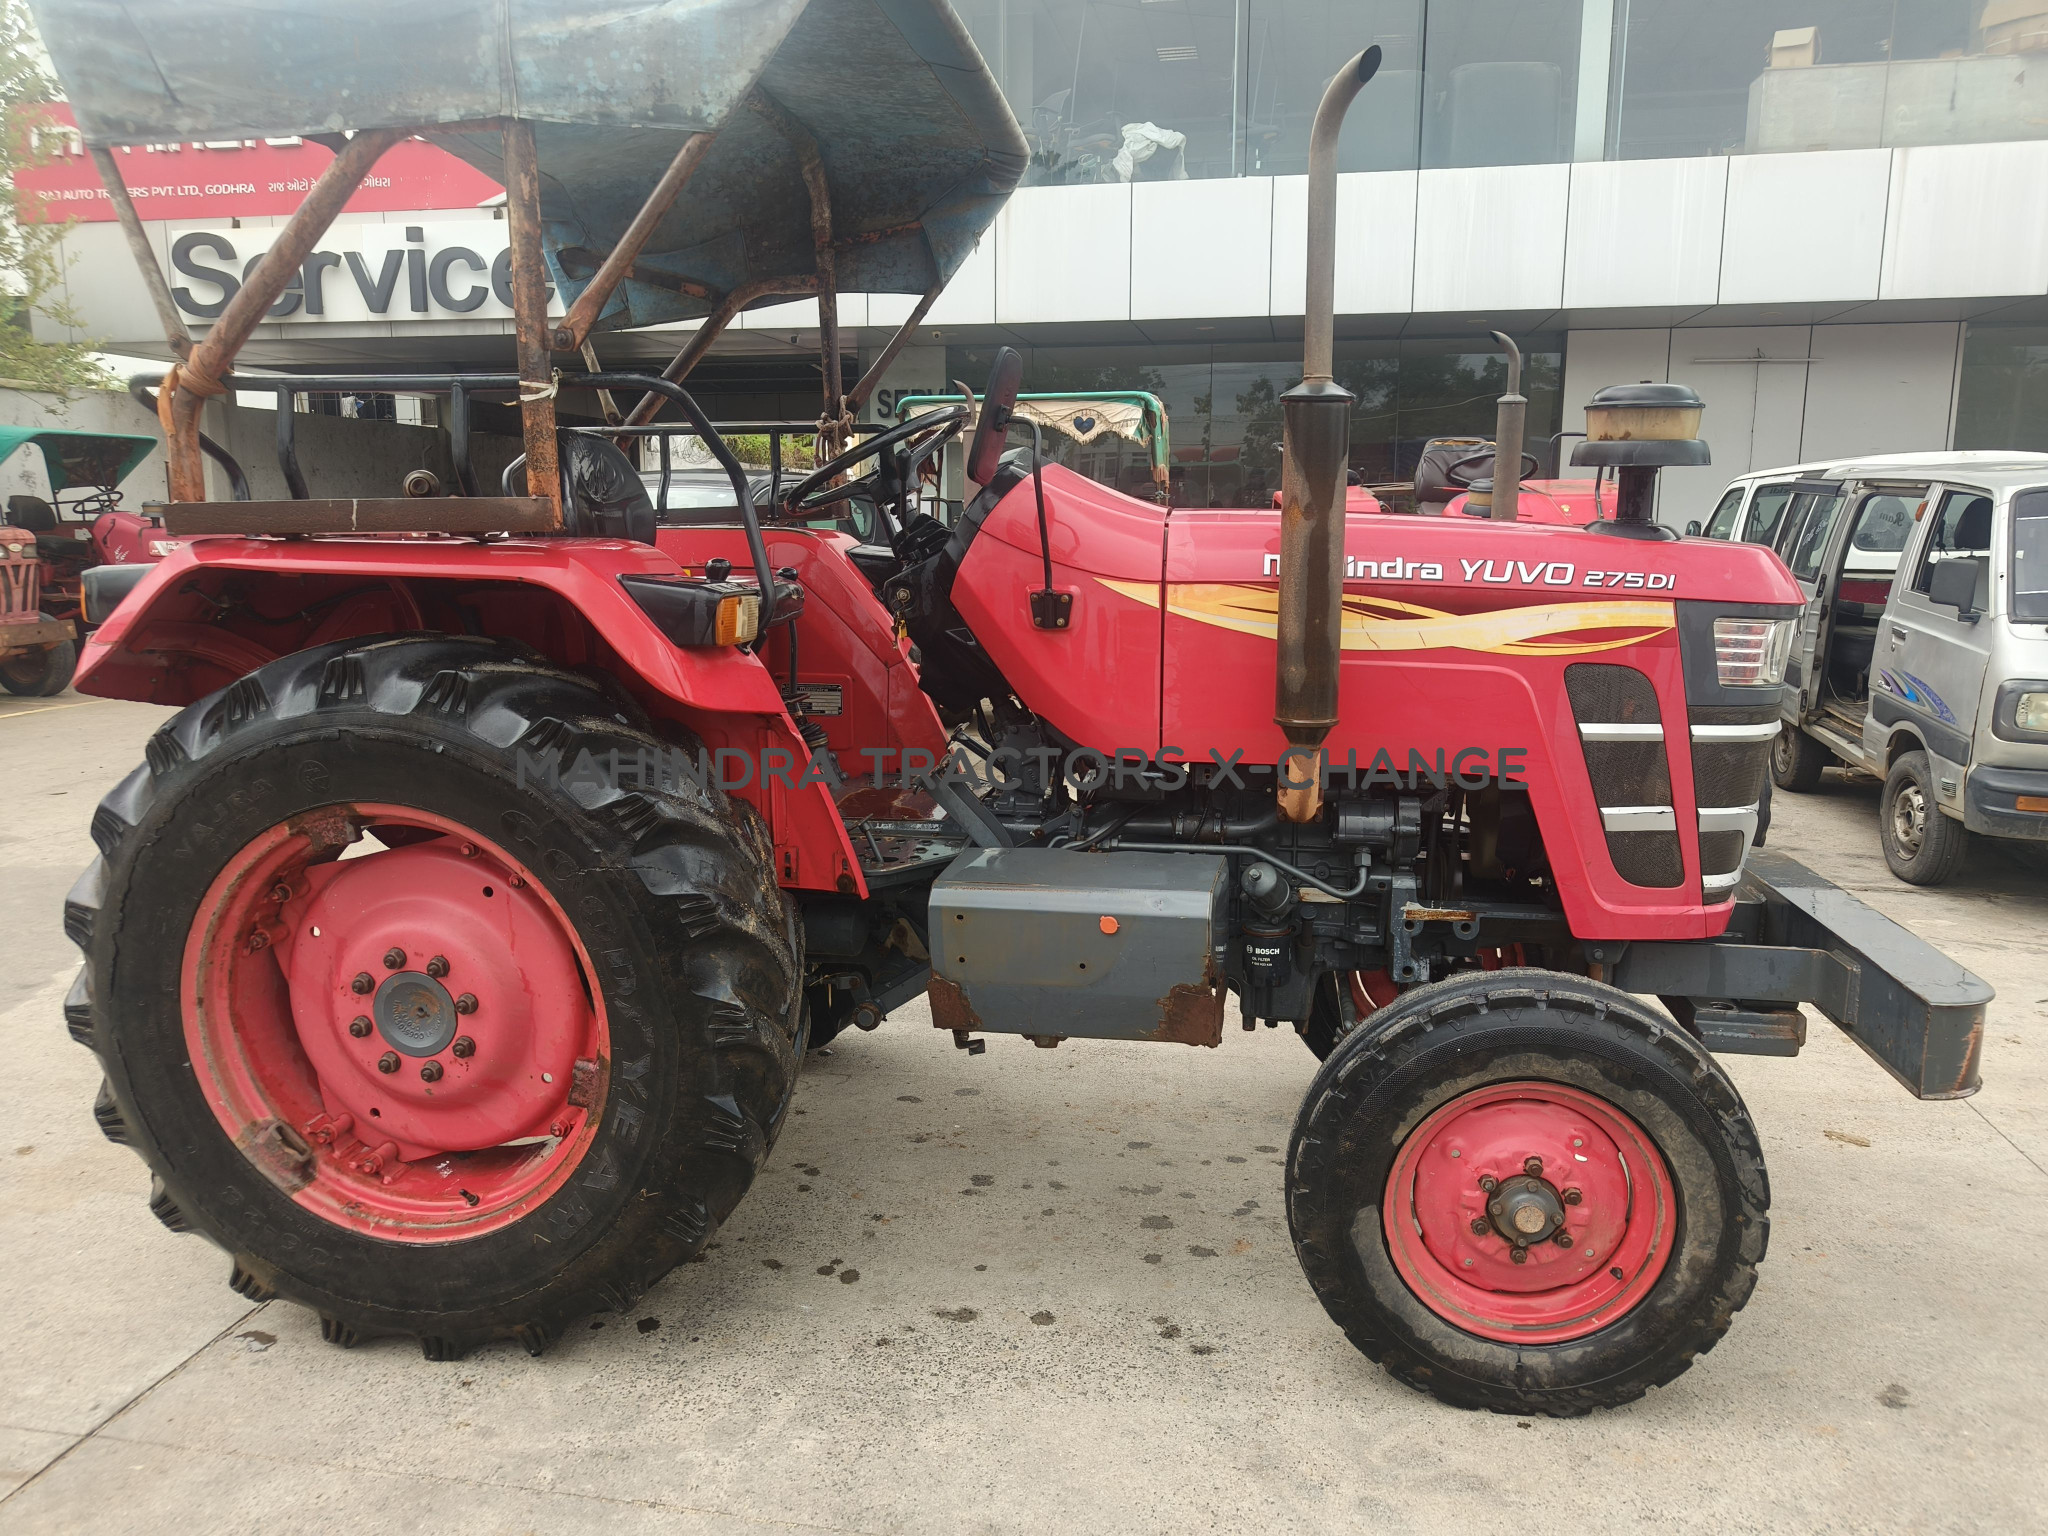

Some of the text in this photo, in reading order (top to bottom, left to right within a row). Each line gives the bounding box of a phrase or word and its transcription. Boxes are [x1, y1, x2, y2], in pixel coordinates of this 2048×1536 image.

[62, 188, 94, 200] AUTO
[95, 186, 149, 199] TRERS
[205, 183, 256, 195] GODHRA
[1262, 553, 1444, 580] Mindra
[1459, 558, 1576, 586] YUVO
[1255, 947, 1280, 955] BOSCH
